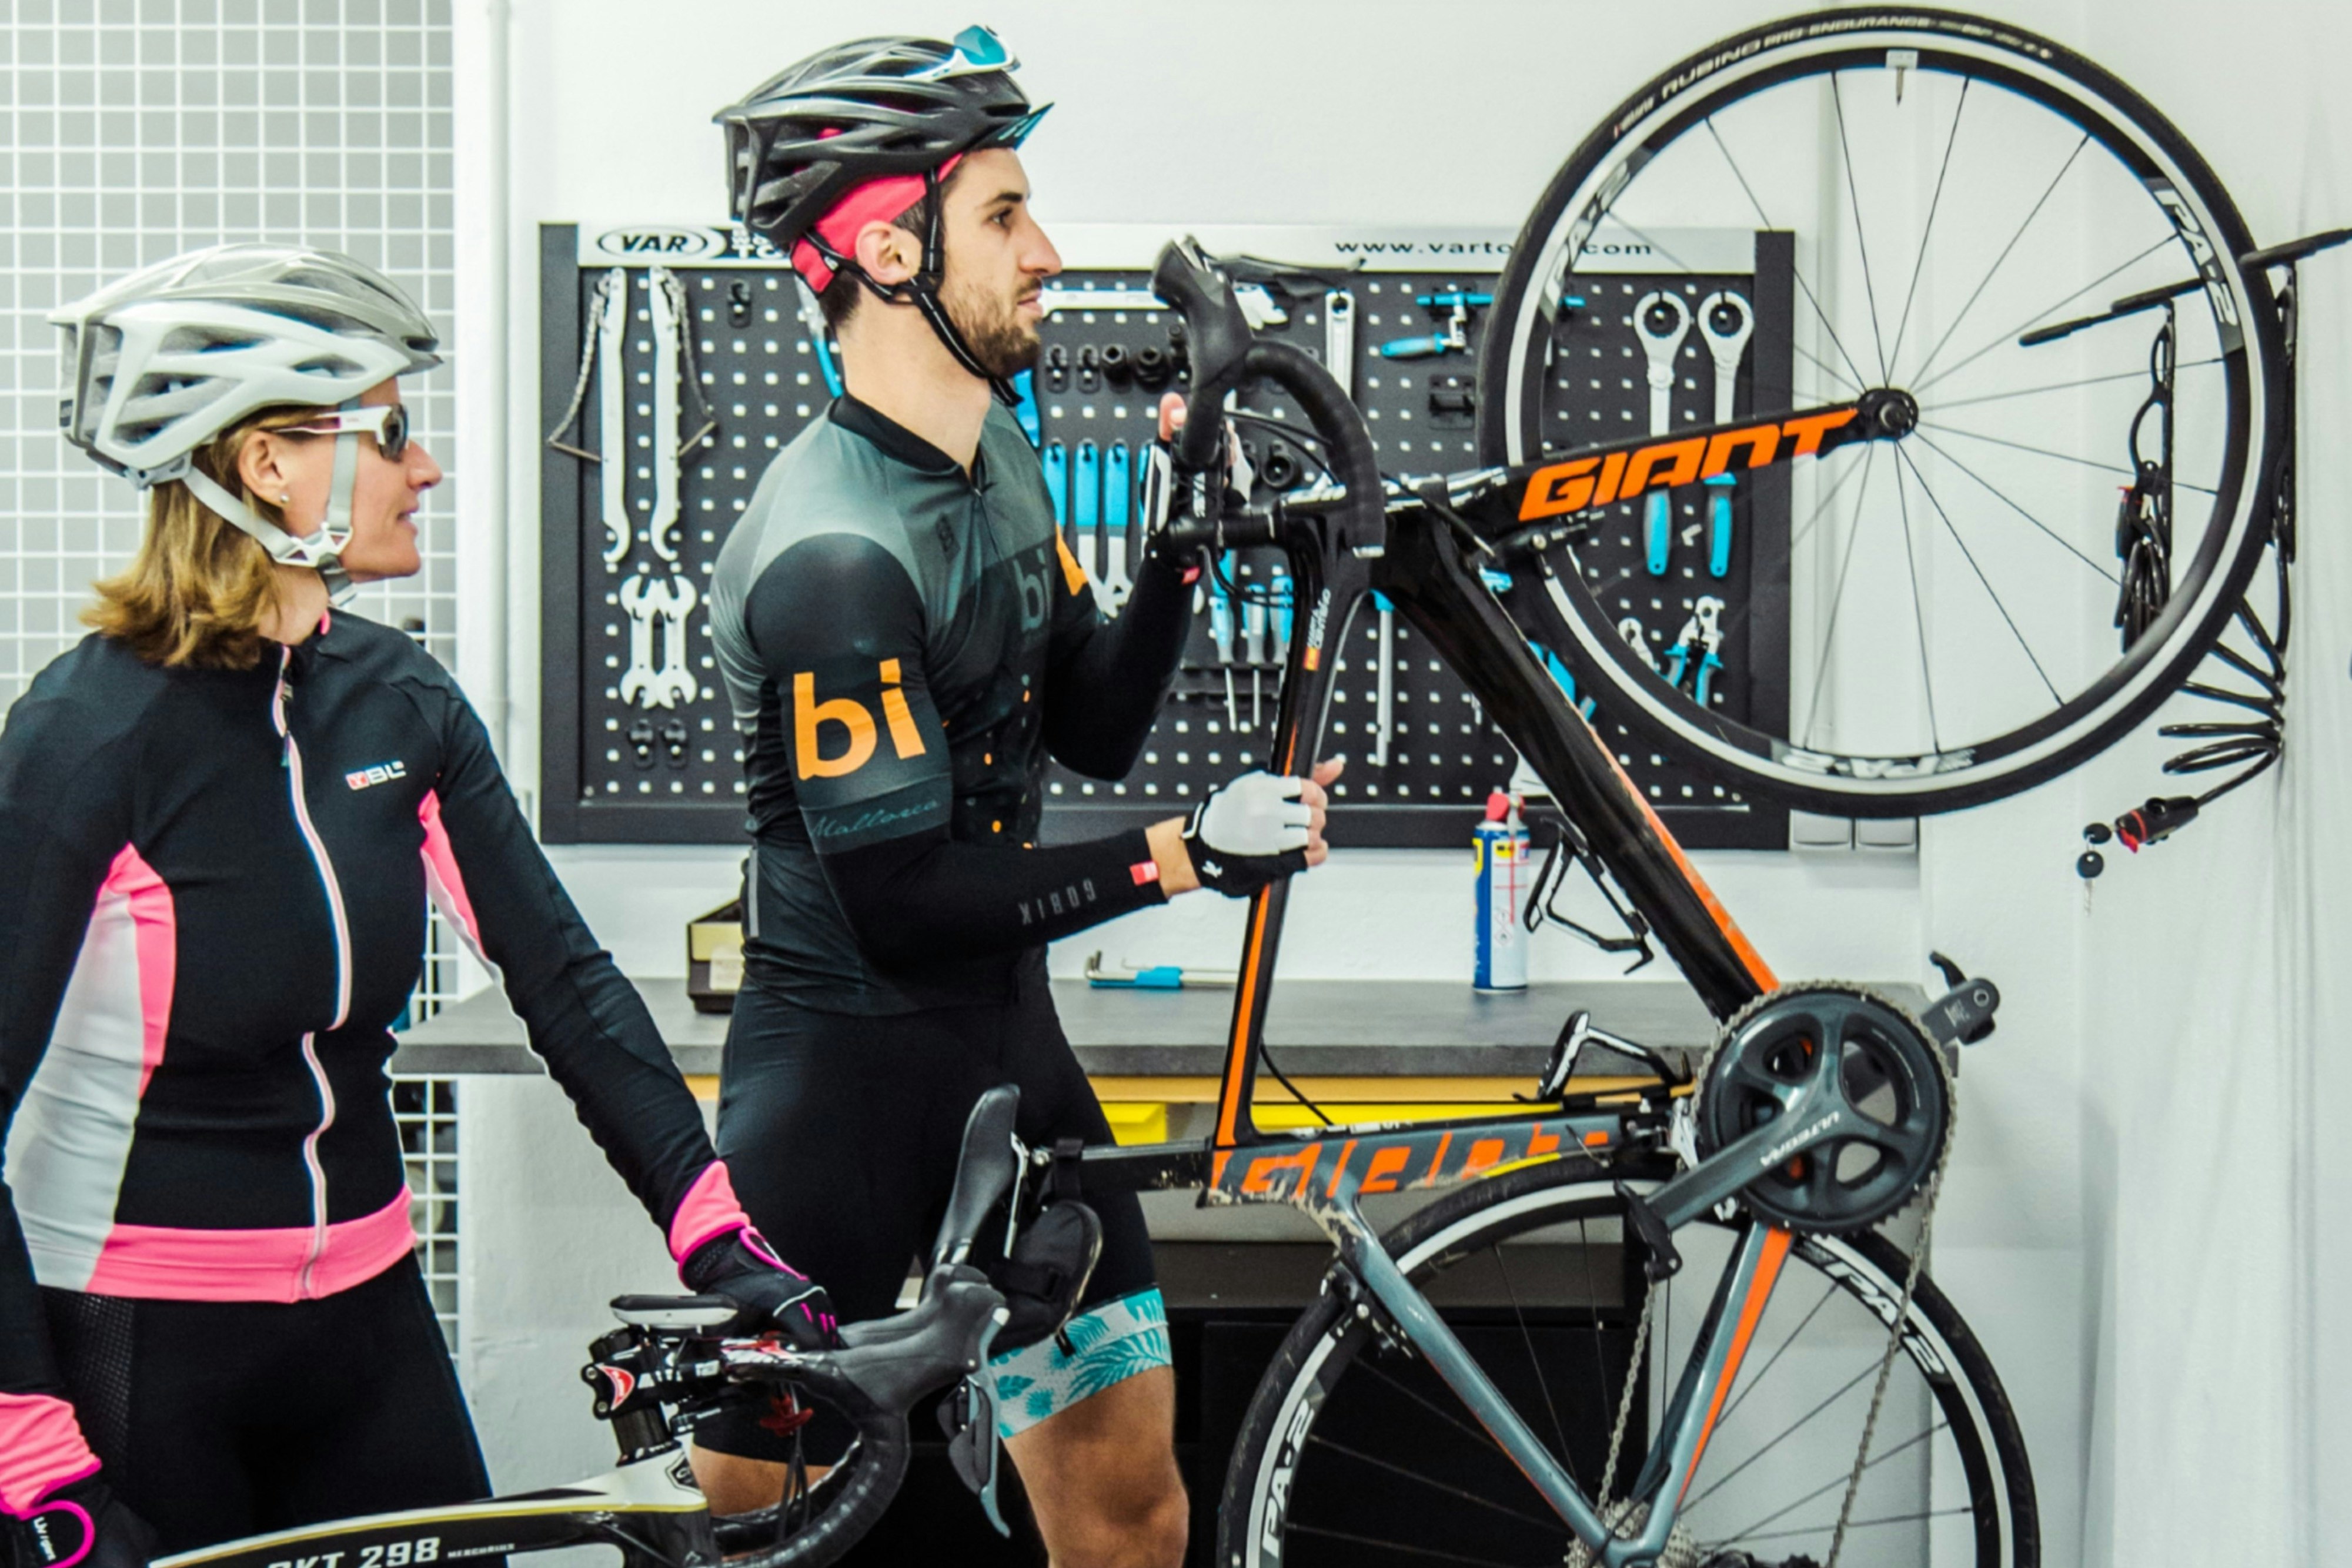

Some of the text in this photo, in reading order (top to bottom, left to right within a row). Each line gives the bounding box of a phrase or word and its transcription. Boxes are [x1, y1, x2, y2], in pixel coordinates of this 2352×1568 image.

[1661, 39, 1760, 100] RUBINO
[1808, 15, 1931, 36] ENDURANCE
[620, 235, 689, 252] VAR
[2153, 189, 2238, 326] PA-2
[1518, 408, 1859, 522] GIANT
[793, 657, 926, 780] bi
[1262, 1398, 1315, 1558] PA-2
[359, 1536, 441, 1568] 298
